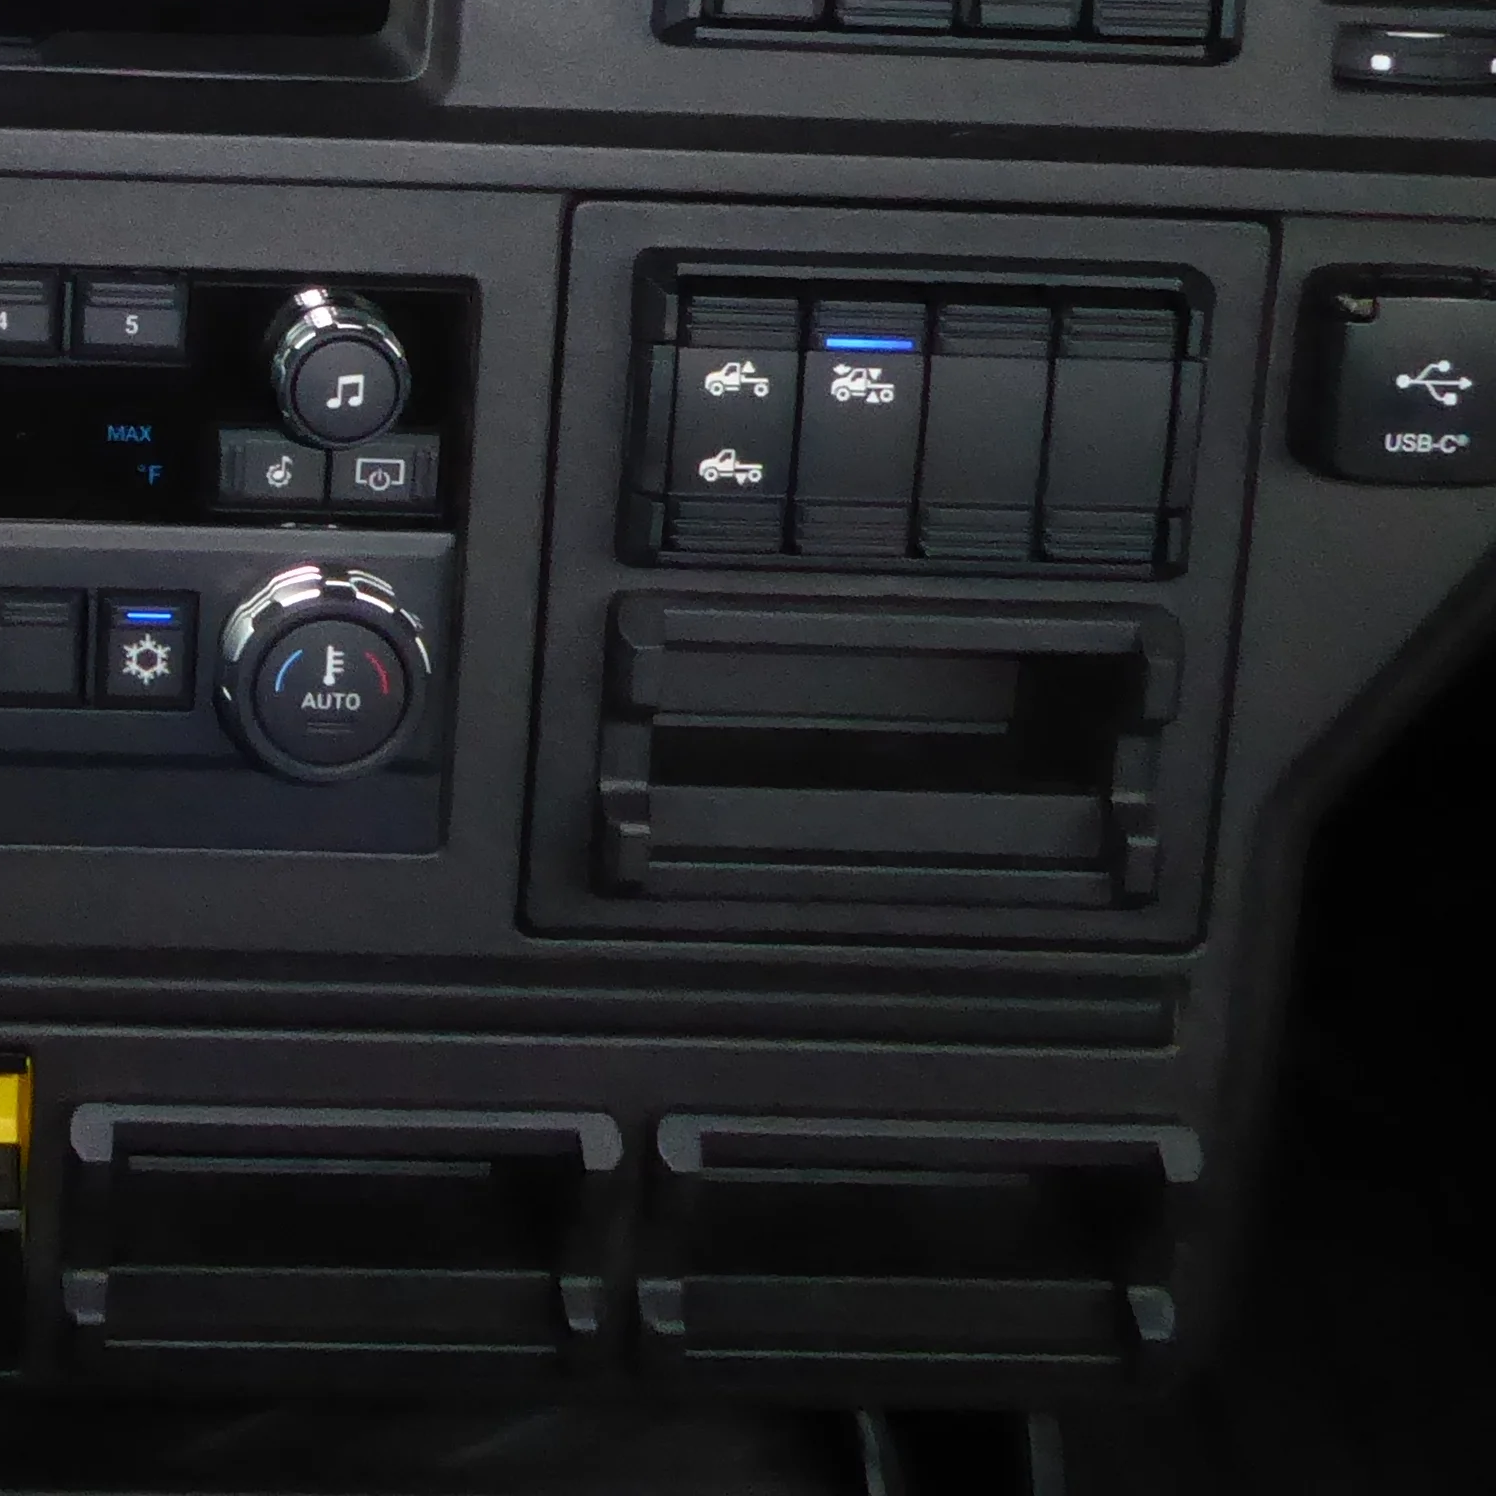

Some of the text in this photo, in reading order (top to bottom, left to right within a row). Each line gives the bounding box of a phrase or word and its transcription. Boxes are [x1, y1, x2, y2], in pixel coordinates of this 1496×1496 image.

[125, 314, 139, 335] 5
[107, 424, 152, 443] MAX
[301, 691, 362, 711] AUTO
